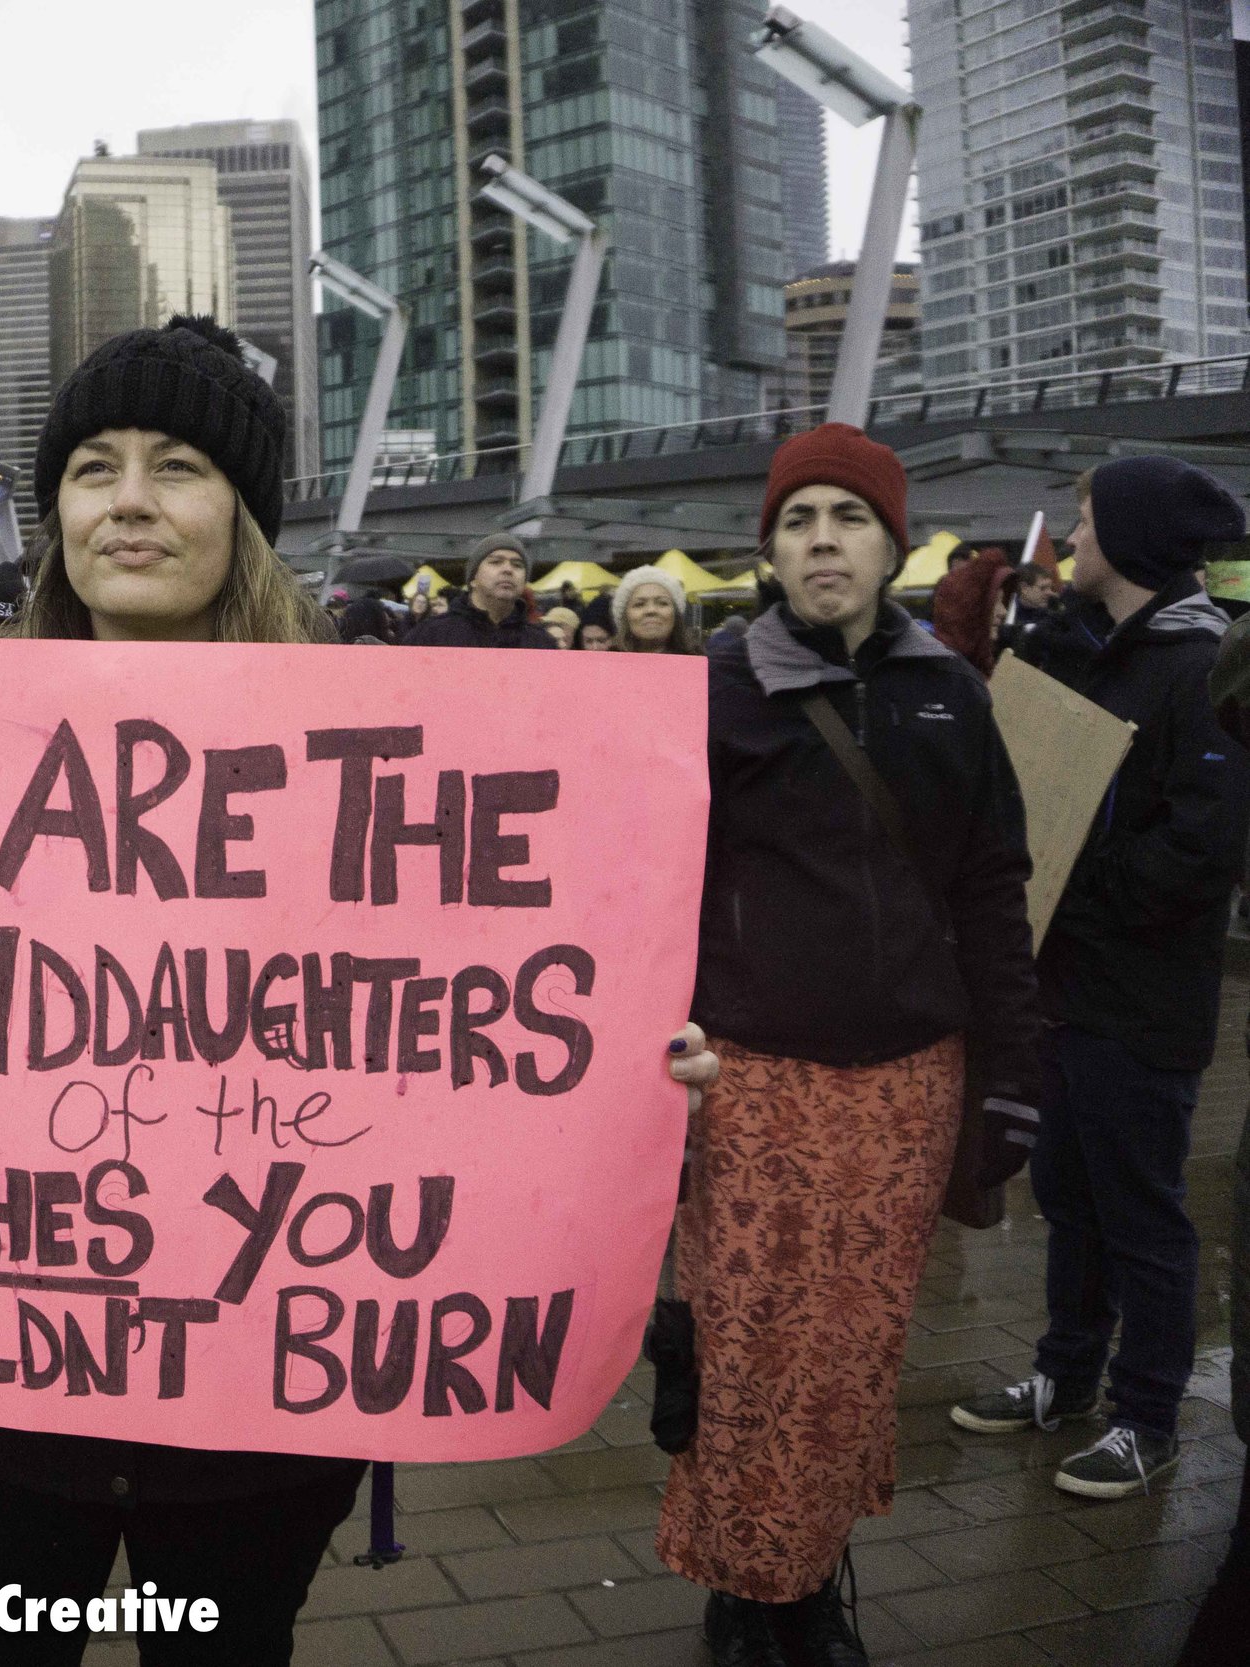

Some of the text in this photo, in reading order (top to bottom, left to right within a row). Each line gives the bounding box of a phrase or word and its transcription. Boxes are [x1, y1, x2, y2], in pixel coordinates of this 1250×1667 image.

[305, 725, 560, 908] THE
[196, 1075, 372, 1156] the
[203, 1161, 455, 1305] YOU
[273, 1284, 576, 1417] BURN
